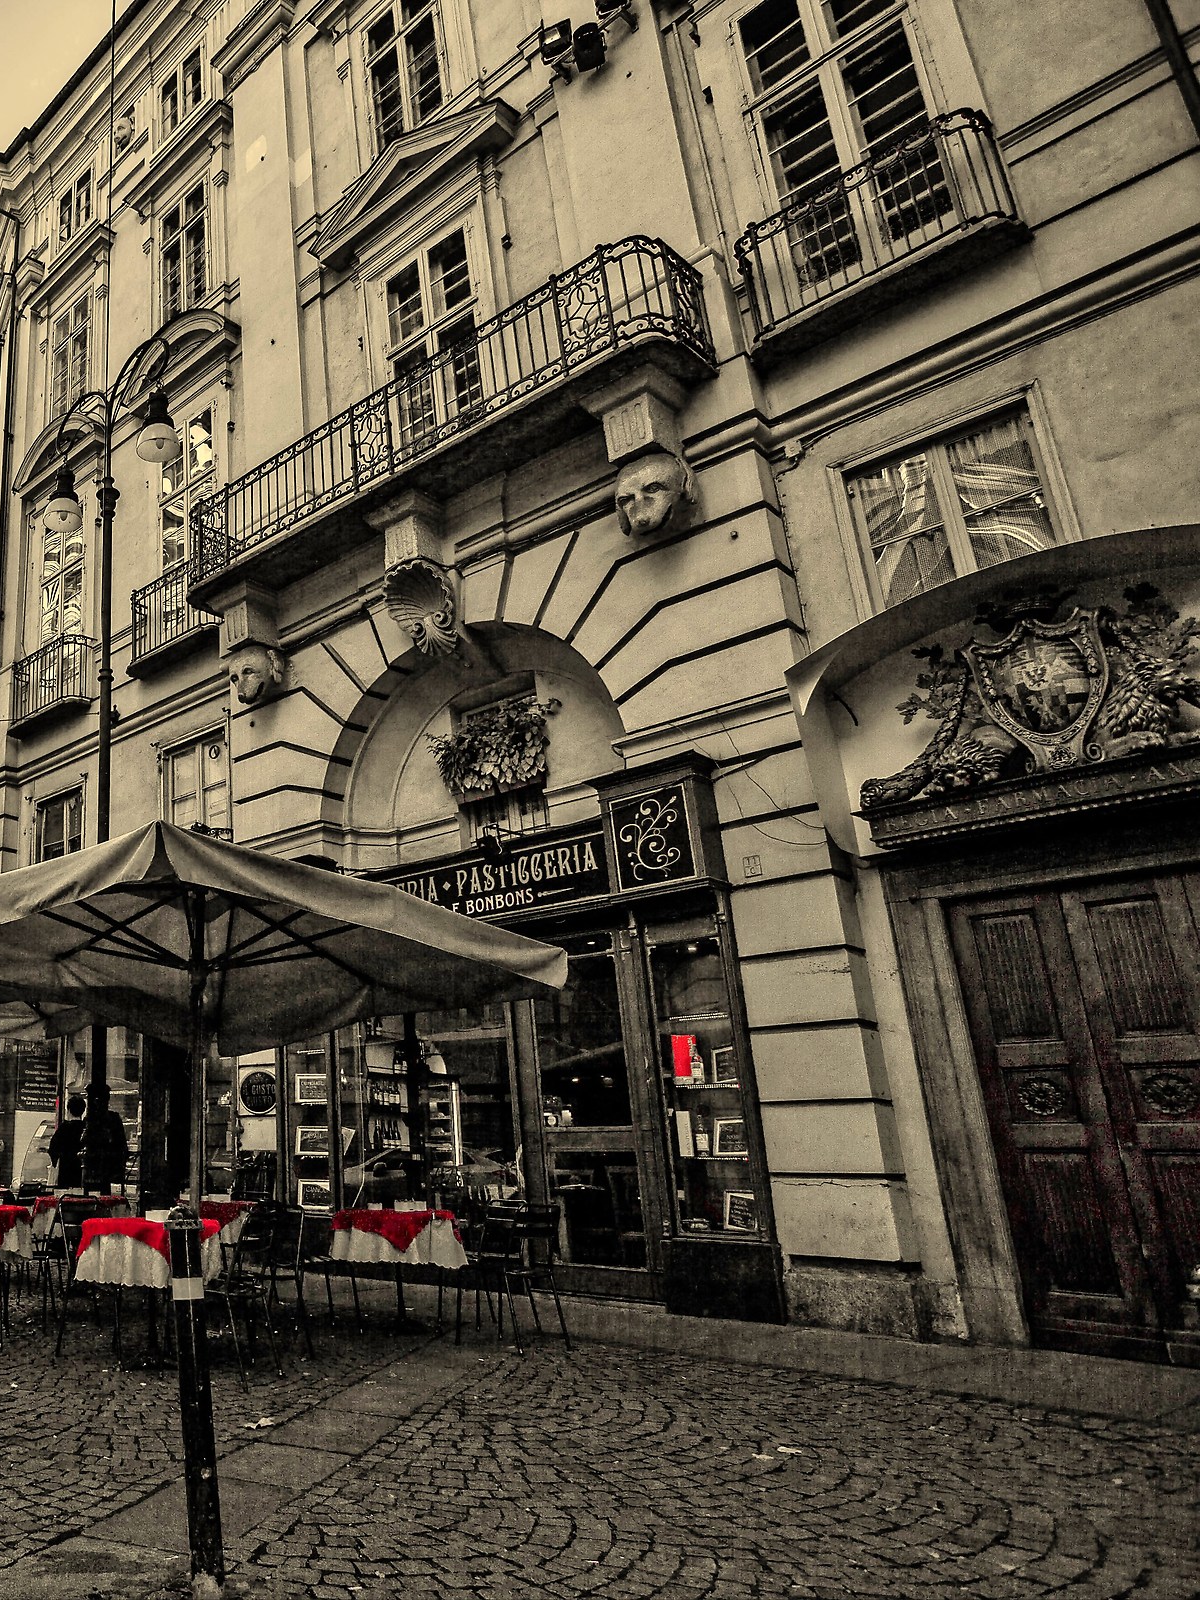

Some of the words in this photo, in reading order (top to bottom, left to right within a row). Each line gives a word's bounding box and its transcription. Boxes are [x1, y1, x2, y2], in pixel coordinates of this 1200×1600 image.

[884, 806, 959, 832] REGIA
[977, 774, 1125, 816] FARMACIA
[466, 887, 534, 915] BONBONS
